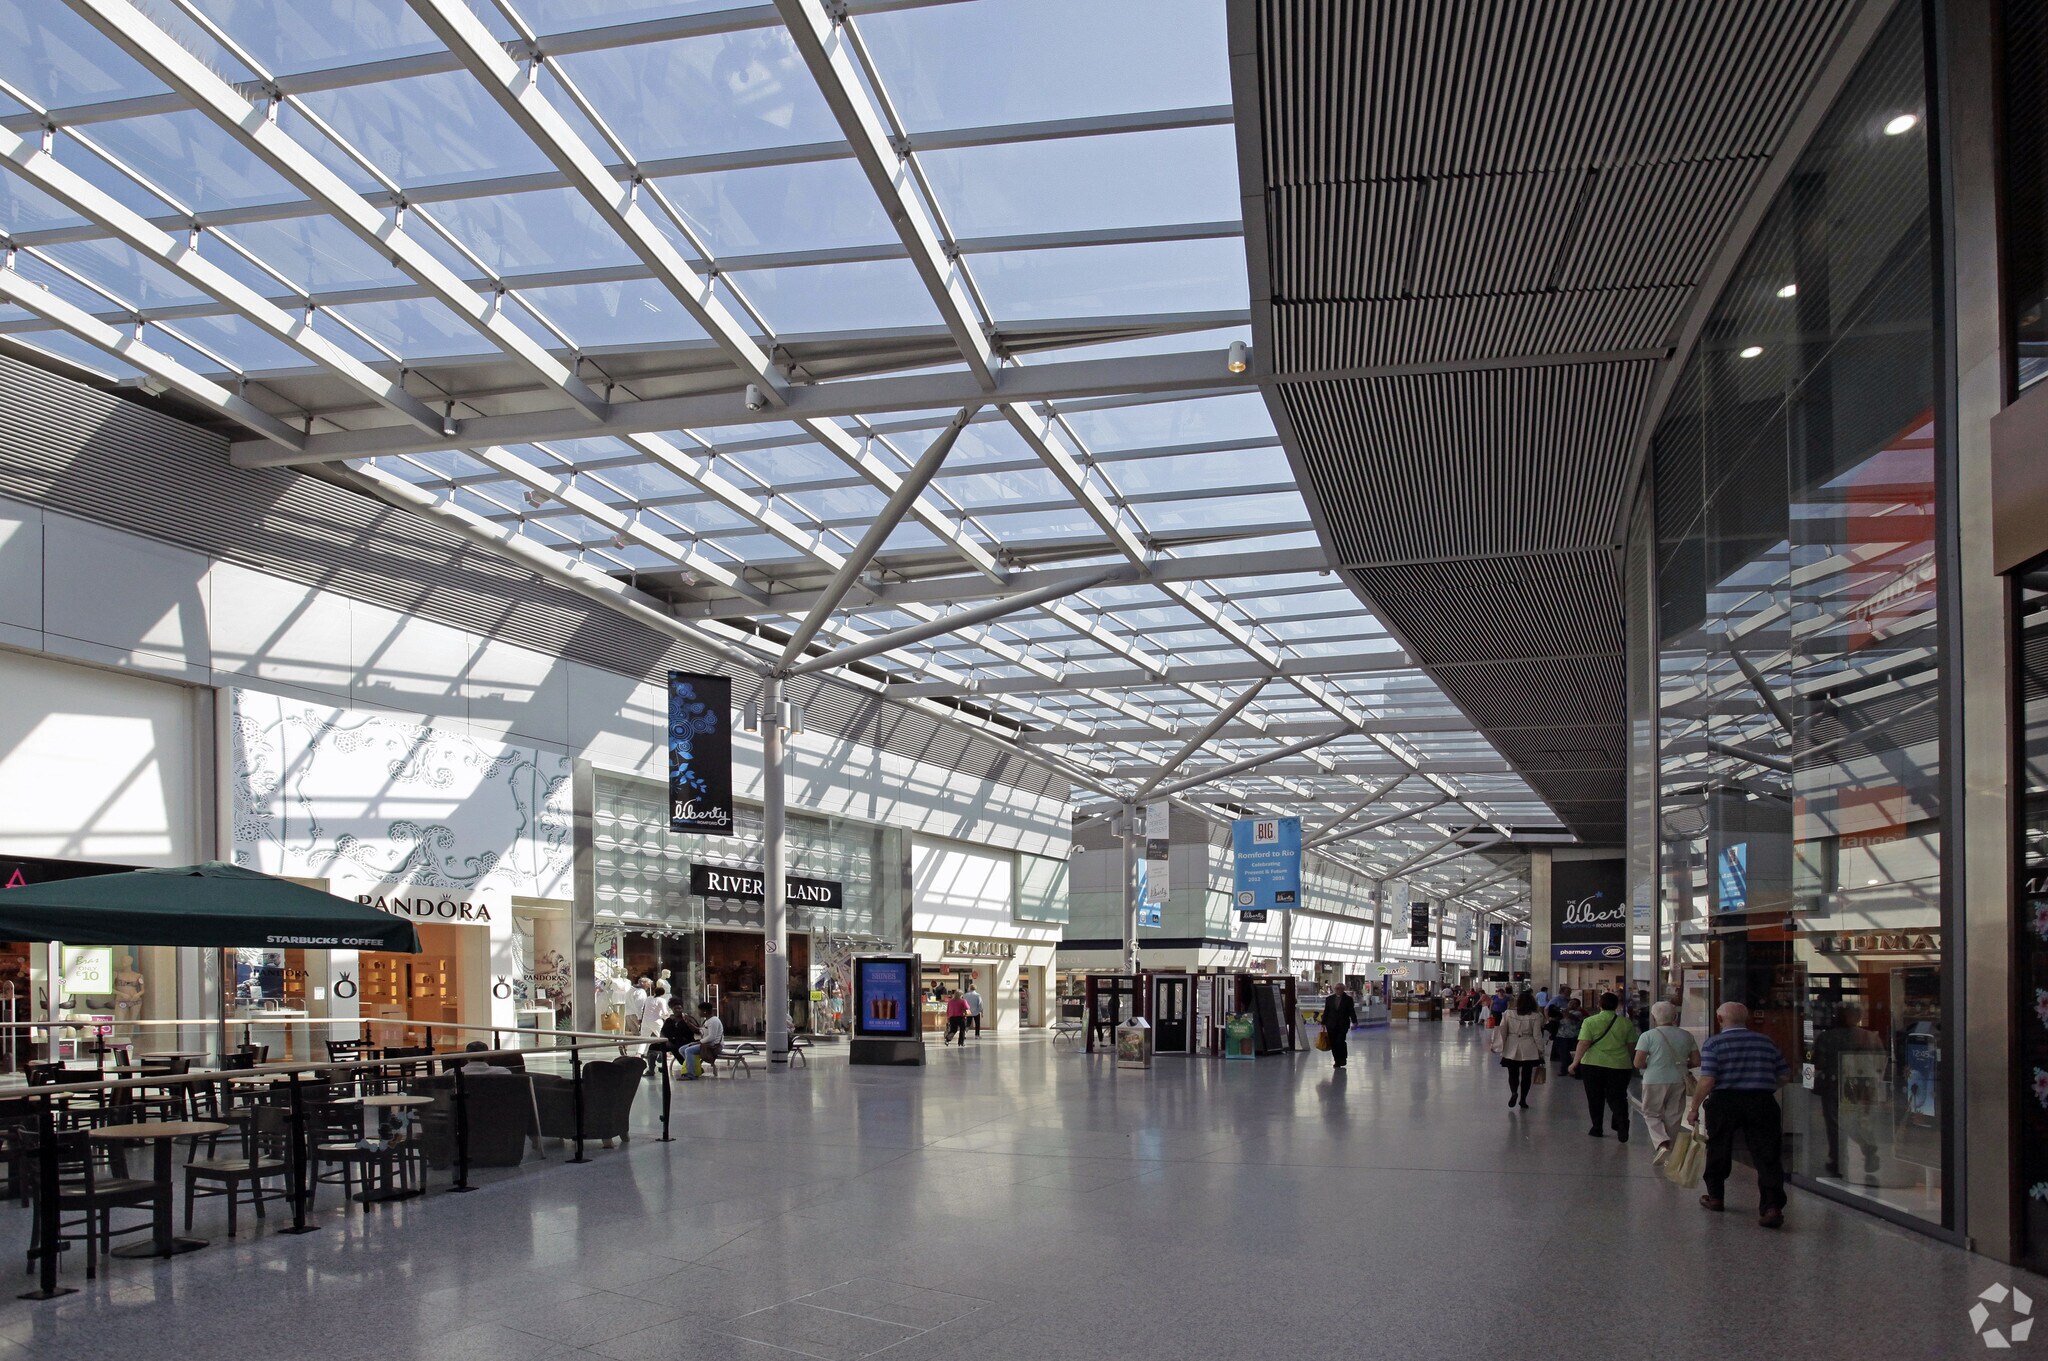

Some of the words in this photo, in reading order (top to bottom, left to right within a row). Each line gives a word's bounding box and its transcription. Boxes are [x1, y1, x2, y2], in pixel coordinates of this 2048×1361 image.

[672, 798, 731, 826] liberty
[1258, 822, 1274, 839] BIG
[1839, 834, 1897, 848] range
[1237, 851, 1270, 859] Romford
[1281, 849, 1295, 857] Rio
[707, 871, 764, 895] RIVER
[787, 883, 831, 902] LAND
[358, 893, 491, 920] PANDORA
[1562, 895, 1626, 924] libert
[267, 935, 338, 945] STARBUCKS
[342, 937, 384, 946] COFFEE
[75, 956, 99, 966] Bras
[523, 974, 563, 982] PANDORA
